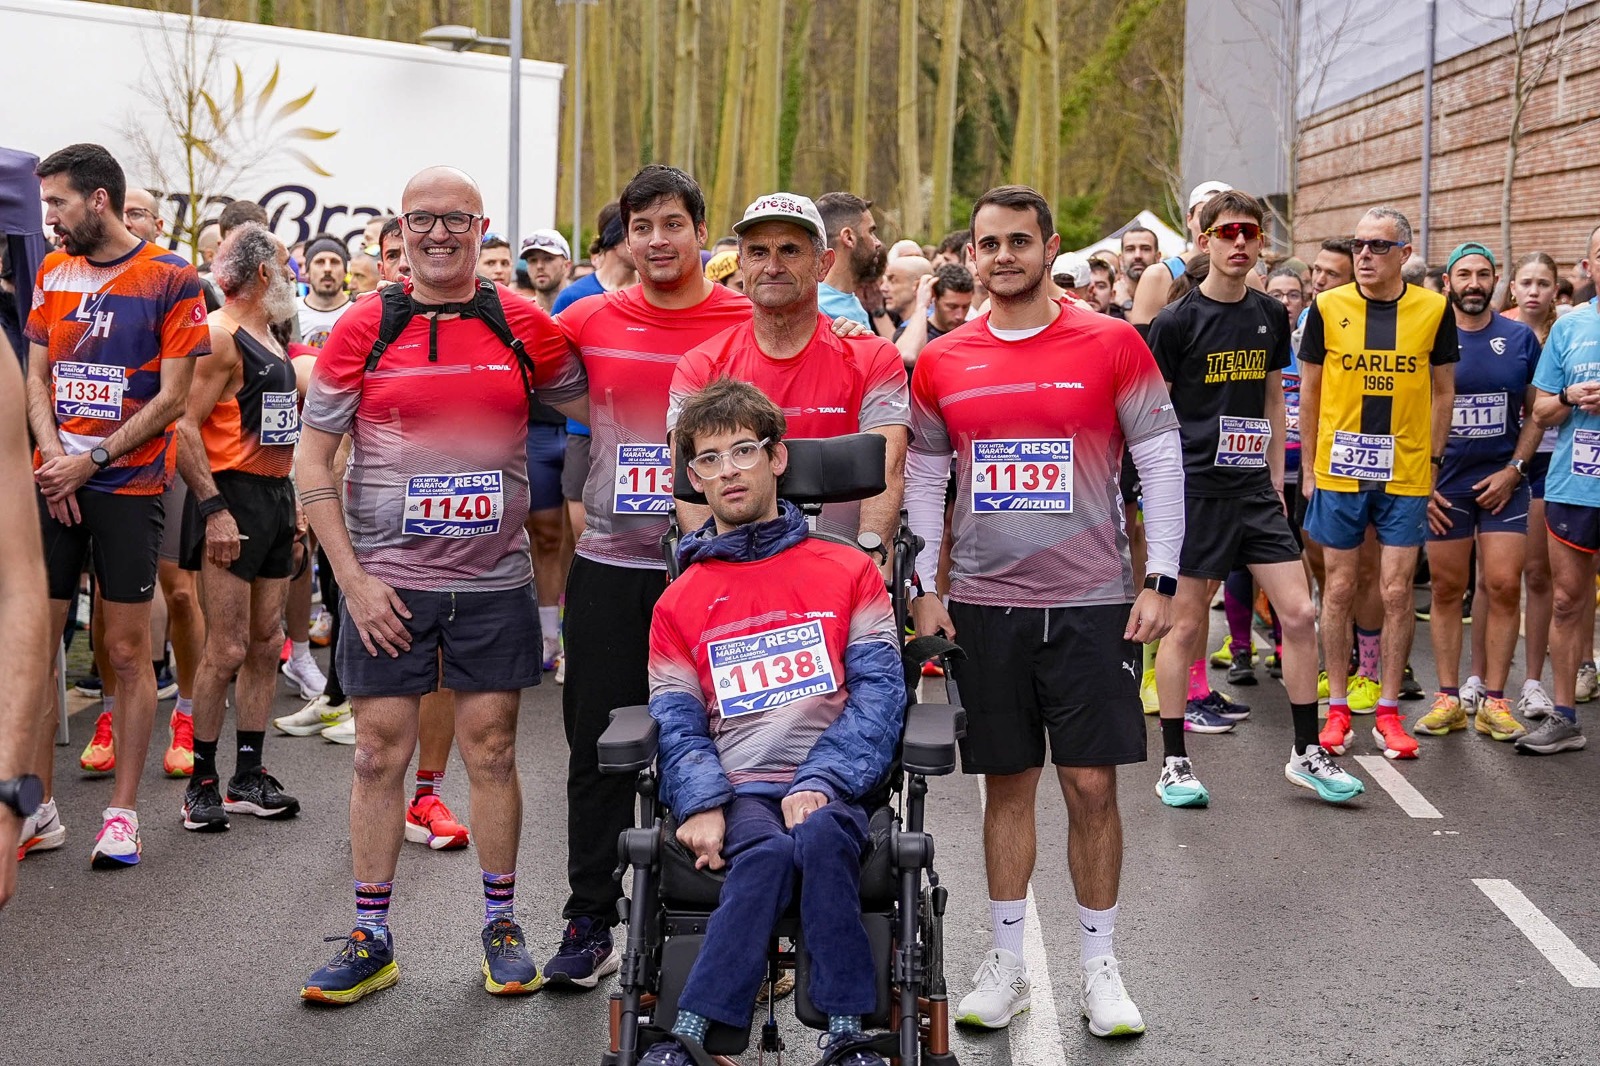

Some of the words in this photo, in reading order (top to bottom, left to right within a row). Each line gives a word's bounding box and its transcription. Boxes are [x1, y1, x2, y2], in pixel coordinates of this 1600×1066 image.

[258, 185, 396, 250] Bra
[1207, 350, 1266, 374] TEAM
[1342, 354, 1417, 373] CARLES
[88, 366, 122, 378] RESOL
[1204, 373, 1228, 384] NAN
[1230, 371, 1266, 380] OLIVERAS
[66, 381, 110, 402] 1334
[1363, 375, 1394, 391] 1966
[1475, 396, 1504, 404] RESOL
[1460, 408, 1491, 424] 111
[1245, 421, 1268, 429] RESOL
[1021, 443, 1069, 454] RESOL
[1228, 434, 1264, 452] 1016
[1362, 437, 1392, 445] RESOL
[1344, 448, 1378, 466] 375
[454, 475, 499, 487] RESOL
[628, 467, 673, 493] 113
[986, 464, 1060, 490] 1139
[420, 495, 491, 520] 1140
[716, 644, 752, 658] MARATÓ
[764, 626, 819, 648] RESOL
[802, 638, 820, 646] Group
[730, 651, 816, 692] 1138
[815, 656, 824, 673] OLOT
